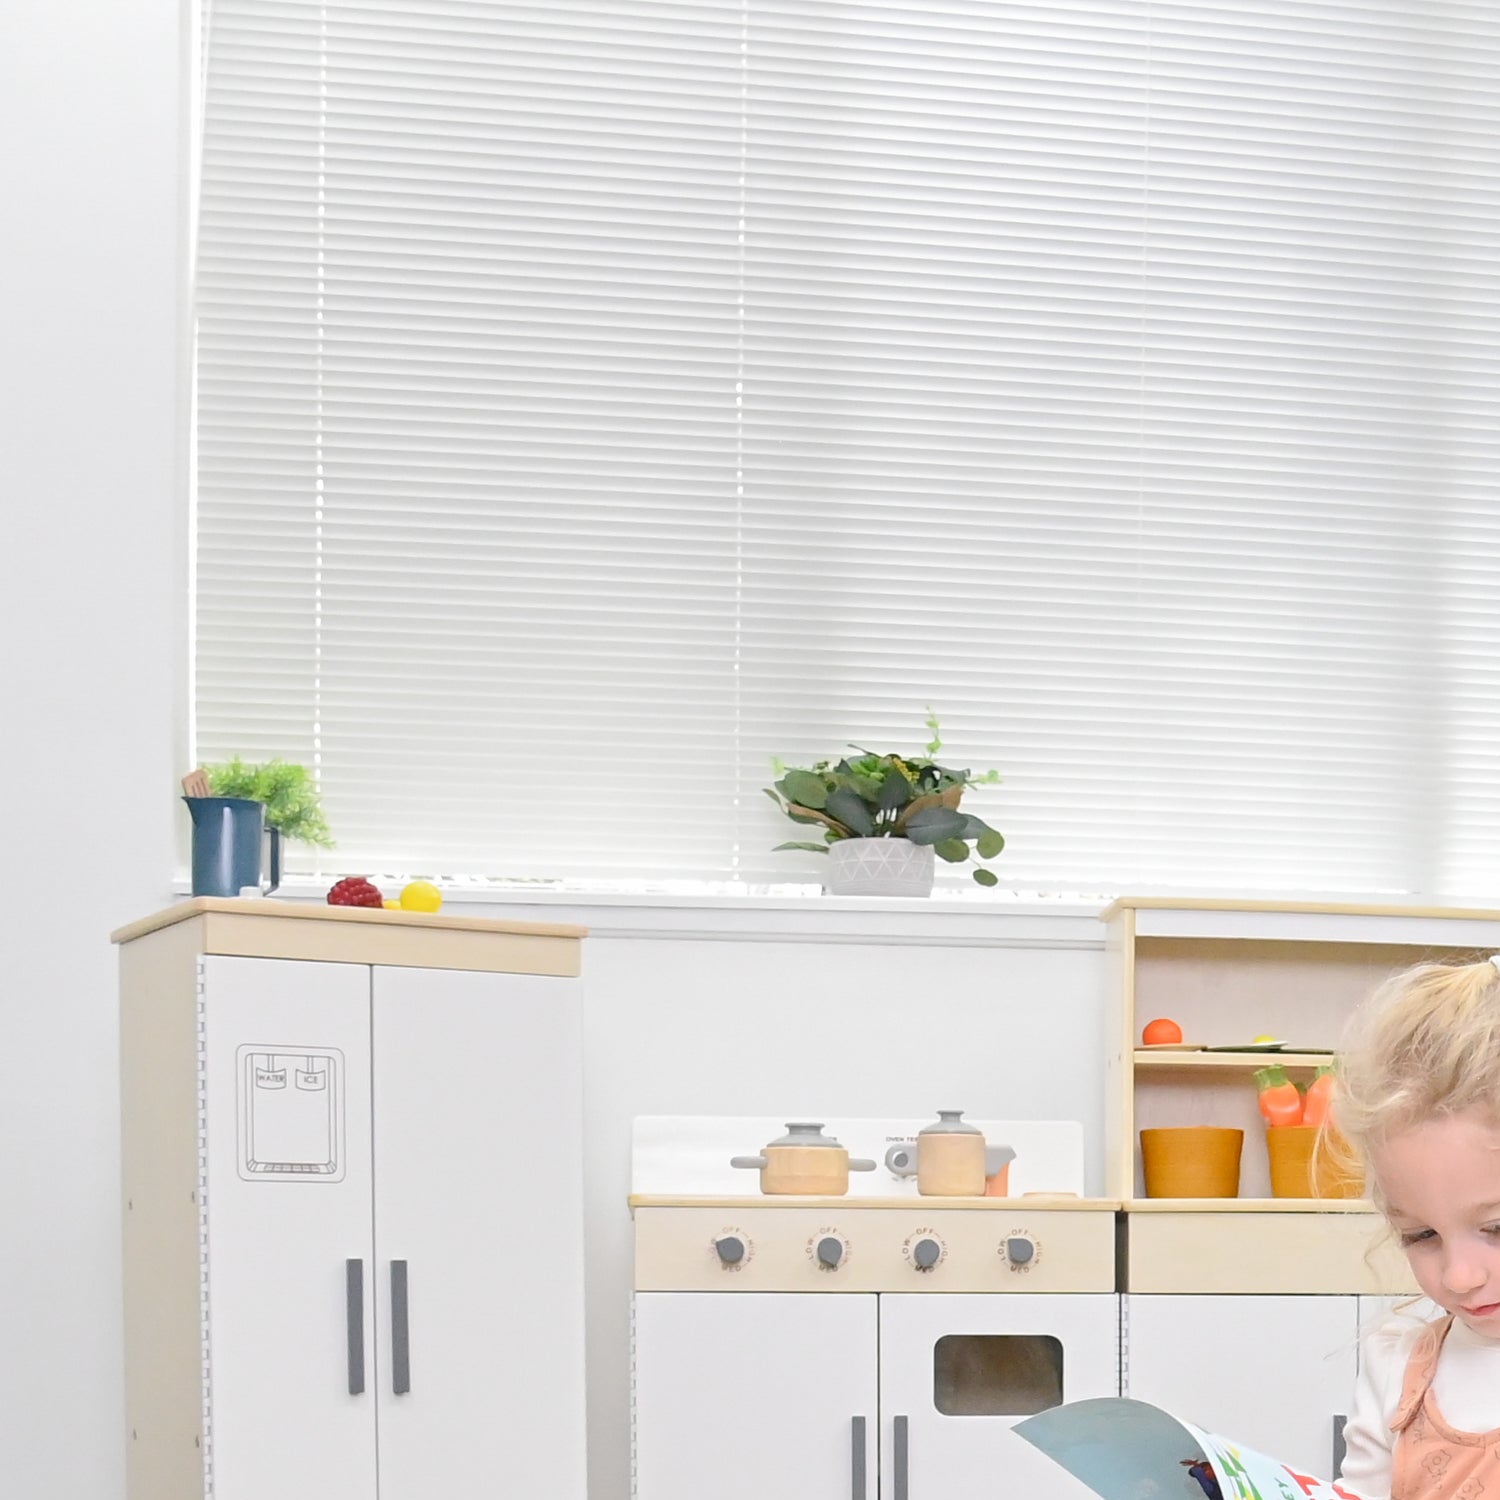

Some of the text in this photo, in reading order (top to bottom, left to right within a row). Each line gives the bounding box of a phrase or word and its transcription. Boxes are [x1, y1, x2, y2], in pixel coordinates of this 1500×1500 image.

[257, 1074, 285, 1082] WATER
[304, 1076, 318, 1084] ICE
[916, 1227, 934, 1235] OFF
